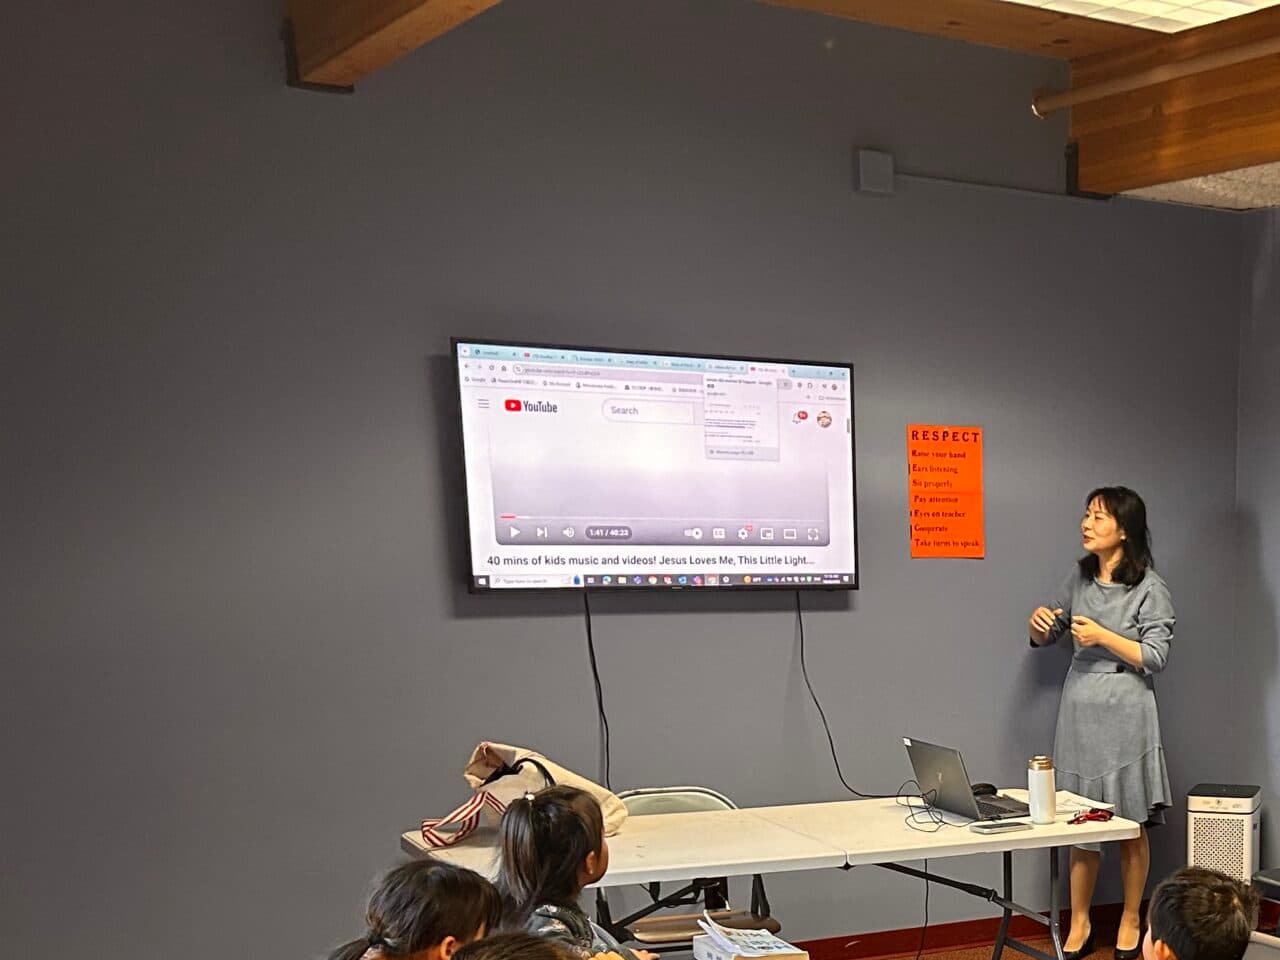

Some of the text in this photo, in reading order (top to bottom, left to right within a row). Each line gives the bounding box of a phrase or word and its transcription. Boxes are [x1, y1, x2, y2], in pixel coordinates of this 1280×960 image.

[523, 400, 558, 413] YouTube
[611, 405, 639, 415] Search
[911, 430, 979, 443] RESPECT
[949, 450, 966, 459] hand
[589, 528, 604, 537] 1:41
[914, 538, 931, 547] Take
[487, 556, 500, 566] 40
[503, 556, 529, 566] mins
[531, 555, 542, 566] of
[544, 555, 566, 566] kids
[568, 556, 599, 566] music
[601, 556, 620, 566] and
[622, 555, 657, 566] videos!
[658, 556, 687, 566] Jesus
[689, 555, 717, 565] Loves
[719, 555, 736, 567] Me,
[737, 555, 758, 566] This
[759, 555, 783, 565] Little
